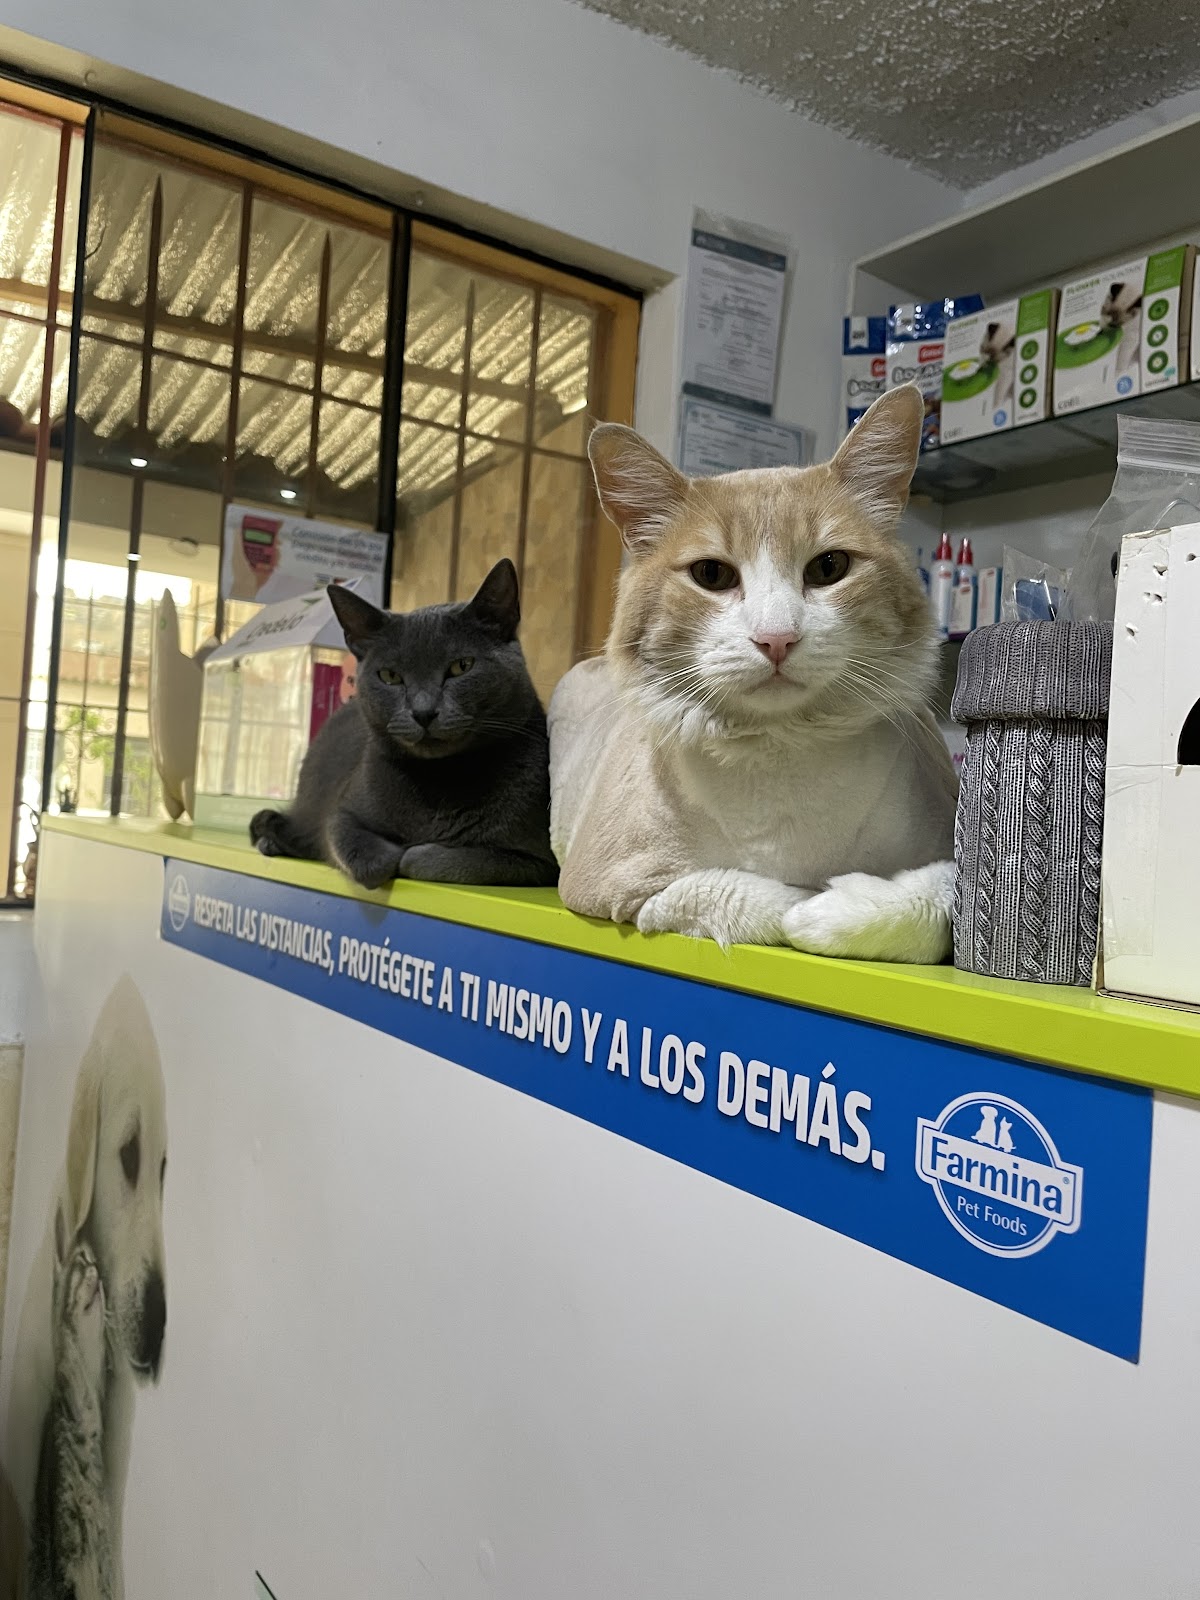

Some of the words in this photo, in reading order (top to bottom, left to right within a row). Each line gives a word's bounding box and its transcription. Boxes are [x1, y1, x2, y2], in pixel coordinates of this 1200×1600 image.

[194, 895, 234, 933] RESPETA
[237, 905, 257, 942] LAS
[259, 912, 334, 976] DISTANCIAS,
[338, 935, 436, 1007] PROTÉGETE
[438, 966, 454, 1013] A
[460, 971, 480, 1022] TI
[485, 980, 573, 1055] MISMO
[581, 1007, 603, 1064] Y
[607, 1018, 630, 1078] A
[640, 1026, 706, 1104] LOS
[717, 1051, 886, 1172] DEMÁS.
[930, 1136, 1063, 1215] Farmina
[957, 1195, 980, 1219] Pet
[984, 1205, 1028, 1237] Foods
